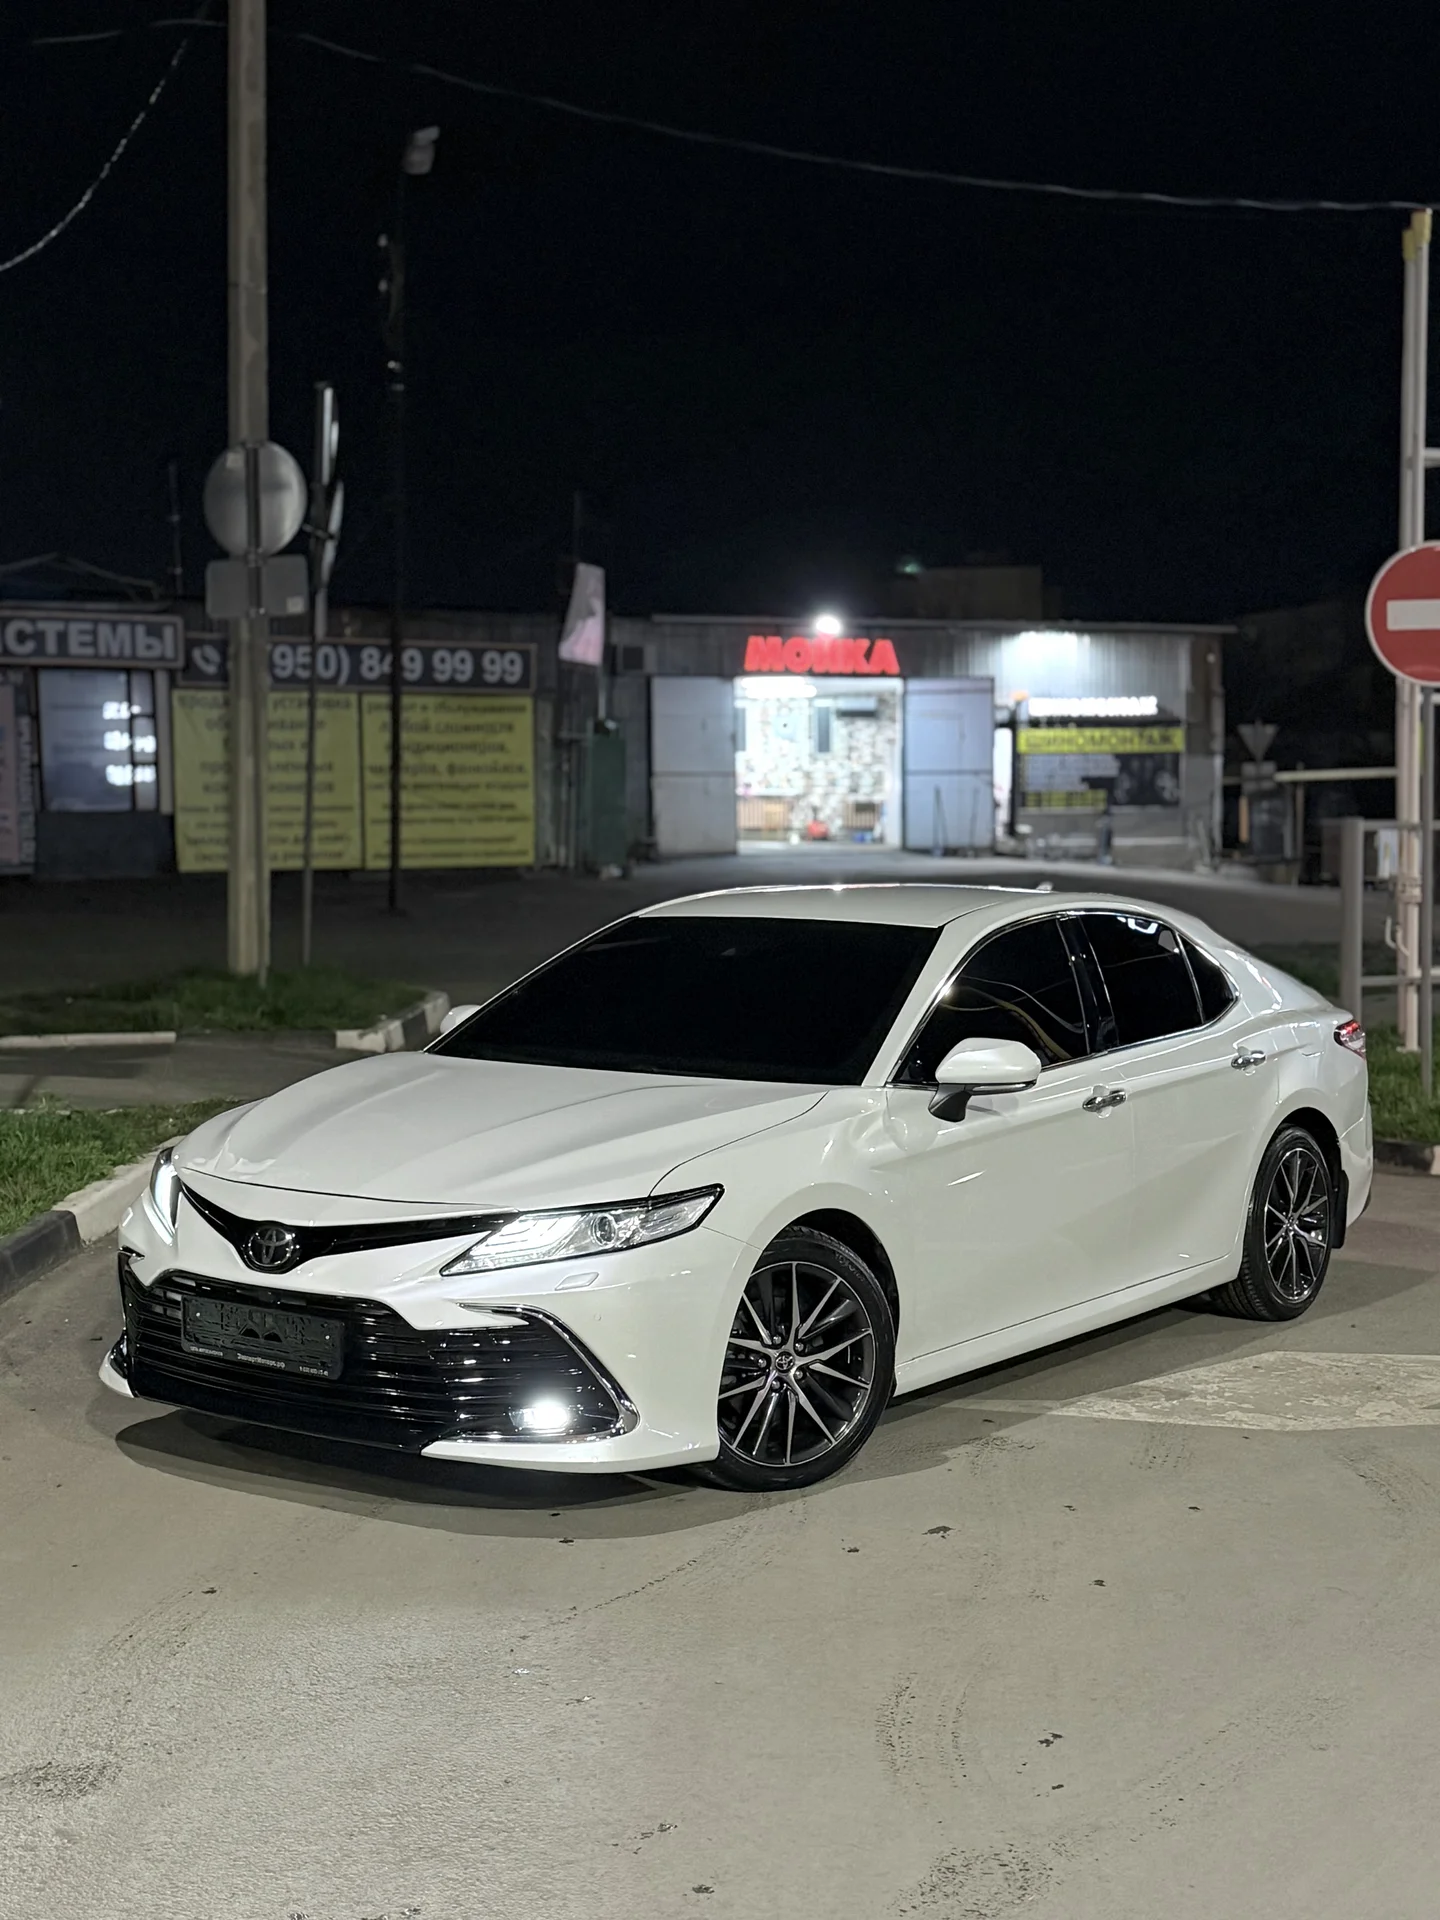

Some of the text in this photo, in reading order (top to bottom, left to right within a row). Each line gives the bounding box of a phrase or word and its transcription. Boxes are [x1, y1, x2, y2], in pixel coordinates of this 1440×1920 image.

[0, 618, 175, 659] СТЕМЫ
[744, 635, 900, 674] МОЙКА
[431, 648, 474, 683] 99
[481, 650, 524, 684] 99
